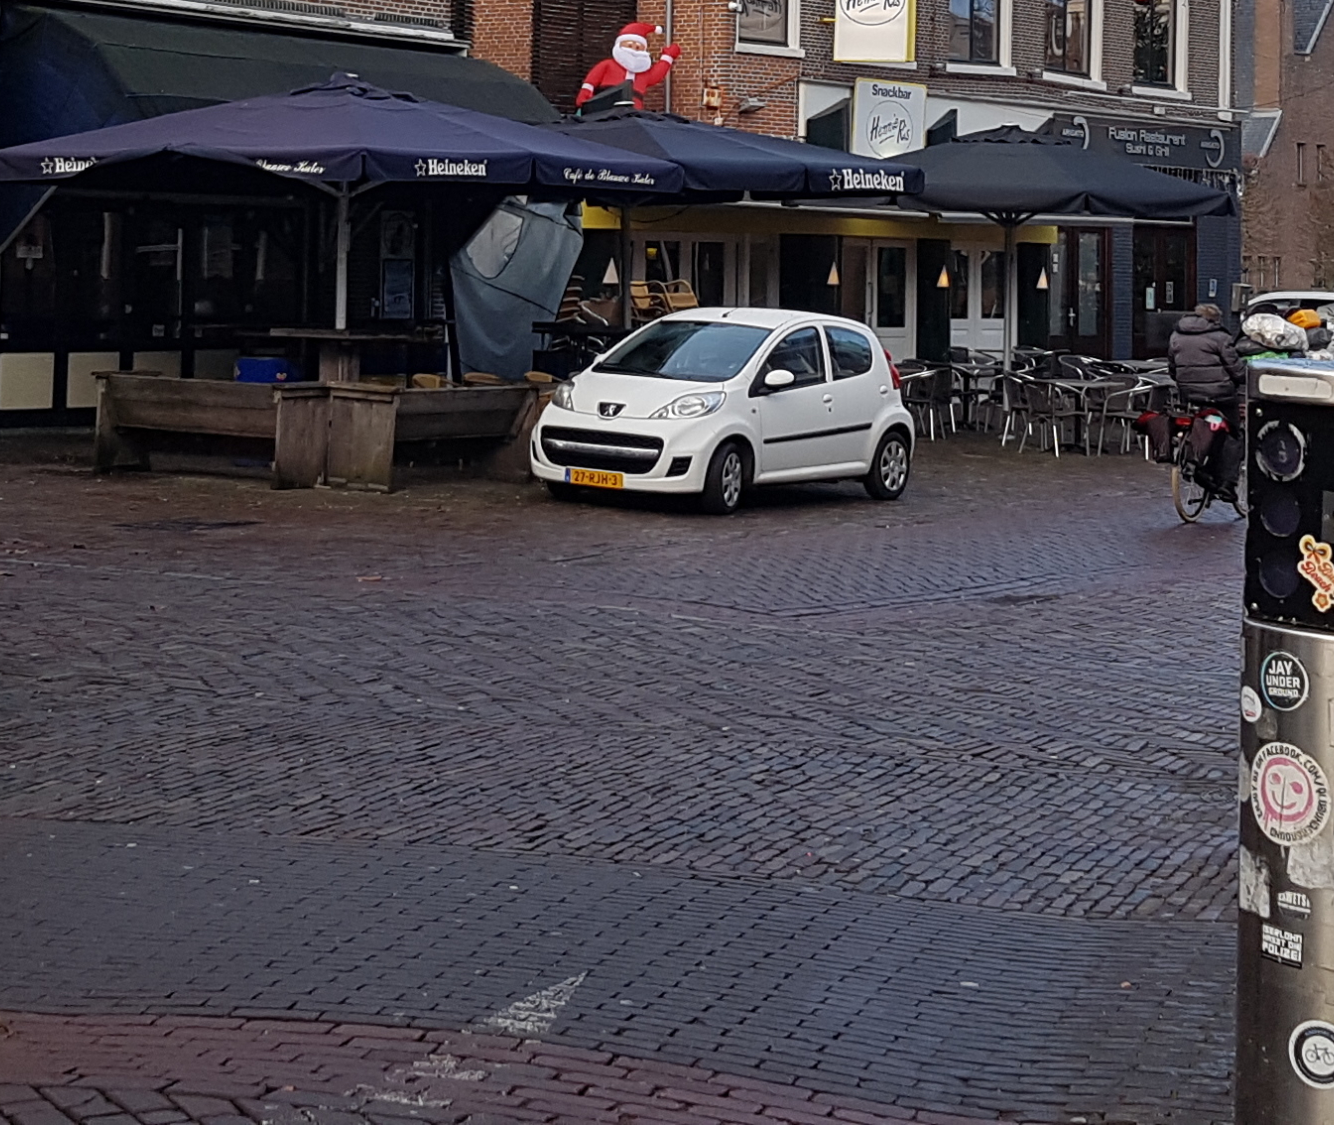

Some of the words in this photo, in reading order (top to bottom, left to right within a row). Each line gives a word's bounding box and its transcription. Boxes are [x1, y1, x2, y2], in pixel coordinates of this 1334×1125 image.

[871, 83, 912, 101] Snackbar
[1108, 126, 1137, 143] Fusion
[427, 158, 487, 177] Heineken
[563, 167, 583, 185] Café
[584, 168, 595, 180] de
[842, 168, 905, 192] Heineken
[573, 470, 618, 486] 27-RJH-3
[1268, 659, 1293, 676] JAY
[1266, 674, 1300, 689] UNDER
[1262, 940, 1302, 963] POLIZEI
